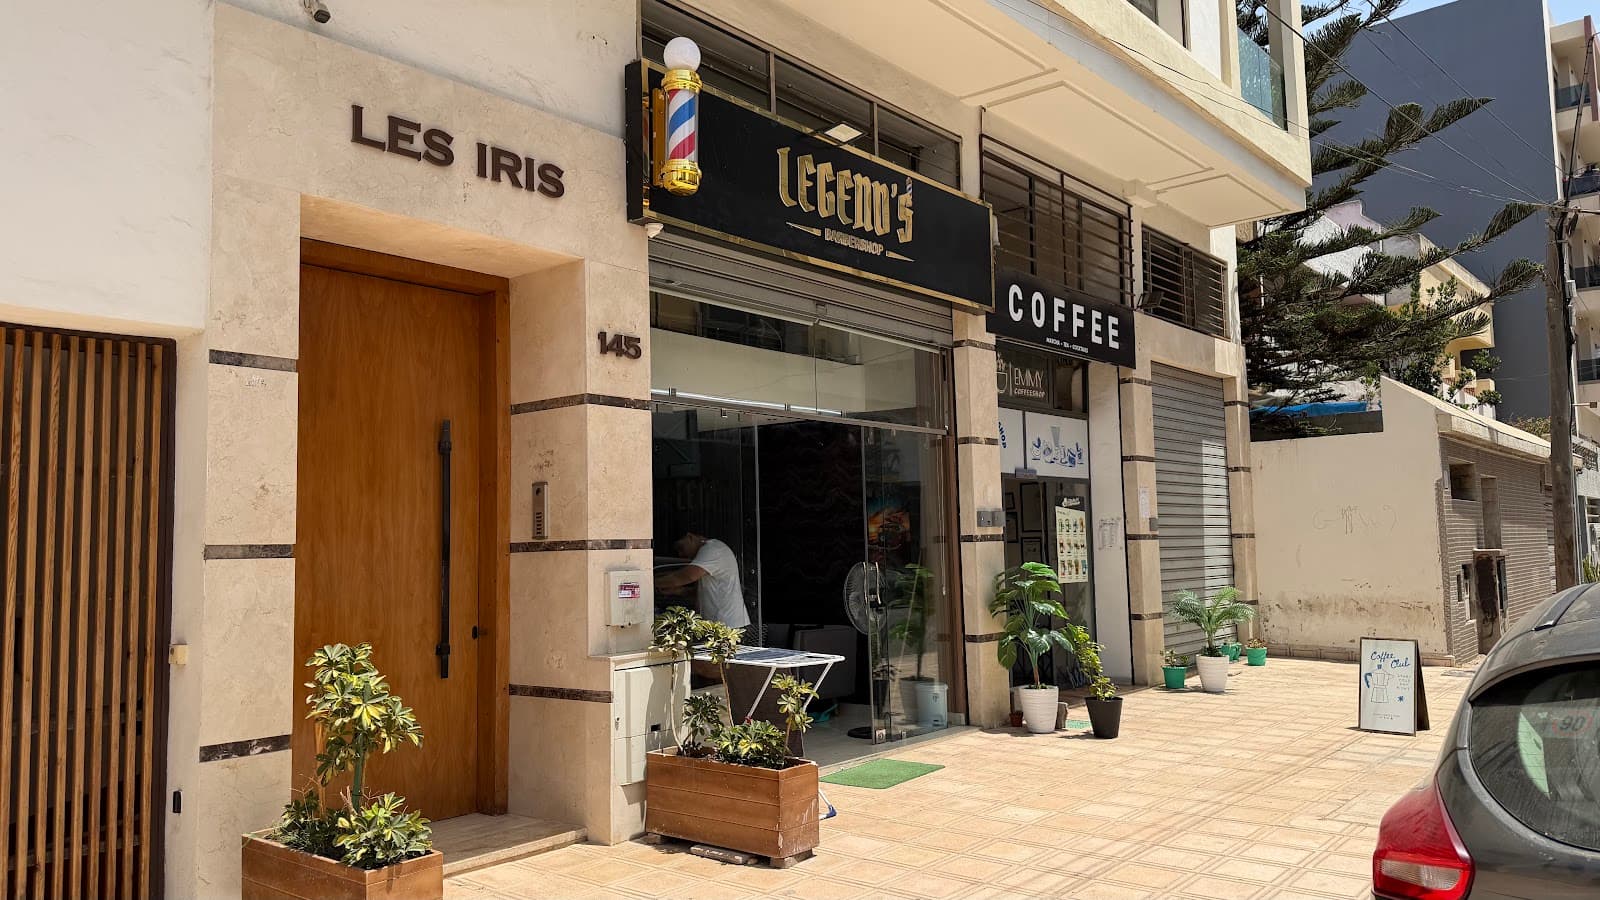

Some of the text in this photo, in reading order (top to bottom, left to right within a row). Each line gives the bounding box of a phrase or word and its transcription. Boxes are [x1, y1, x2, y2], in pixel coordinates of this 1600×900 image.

[351, 104, 565, 199] LES IRIS
[776, 147, 914, 243] LEGEND'S
[824, 227, 884, 256] BARBERSHOP
[1008, 283, 1120, 350] COFFEE
[597, 330, 642, 360] 145
[1014, 367, 1044, 388] EMMY
[1370, 651, 1395, 663] Coffee
